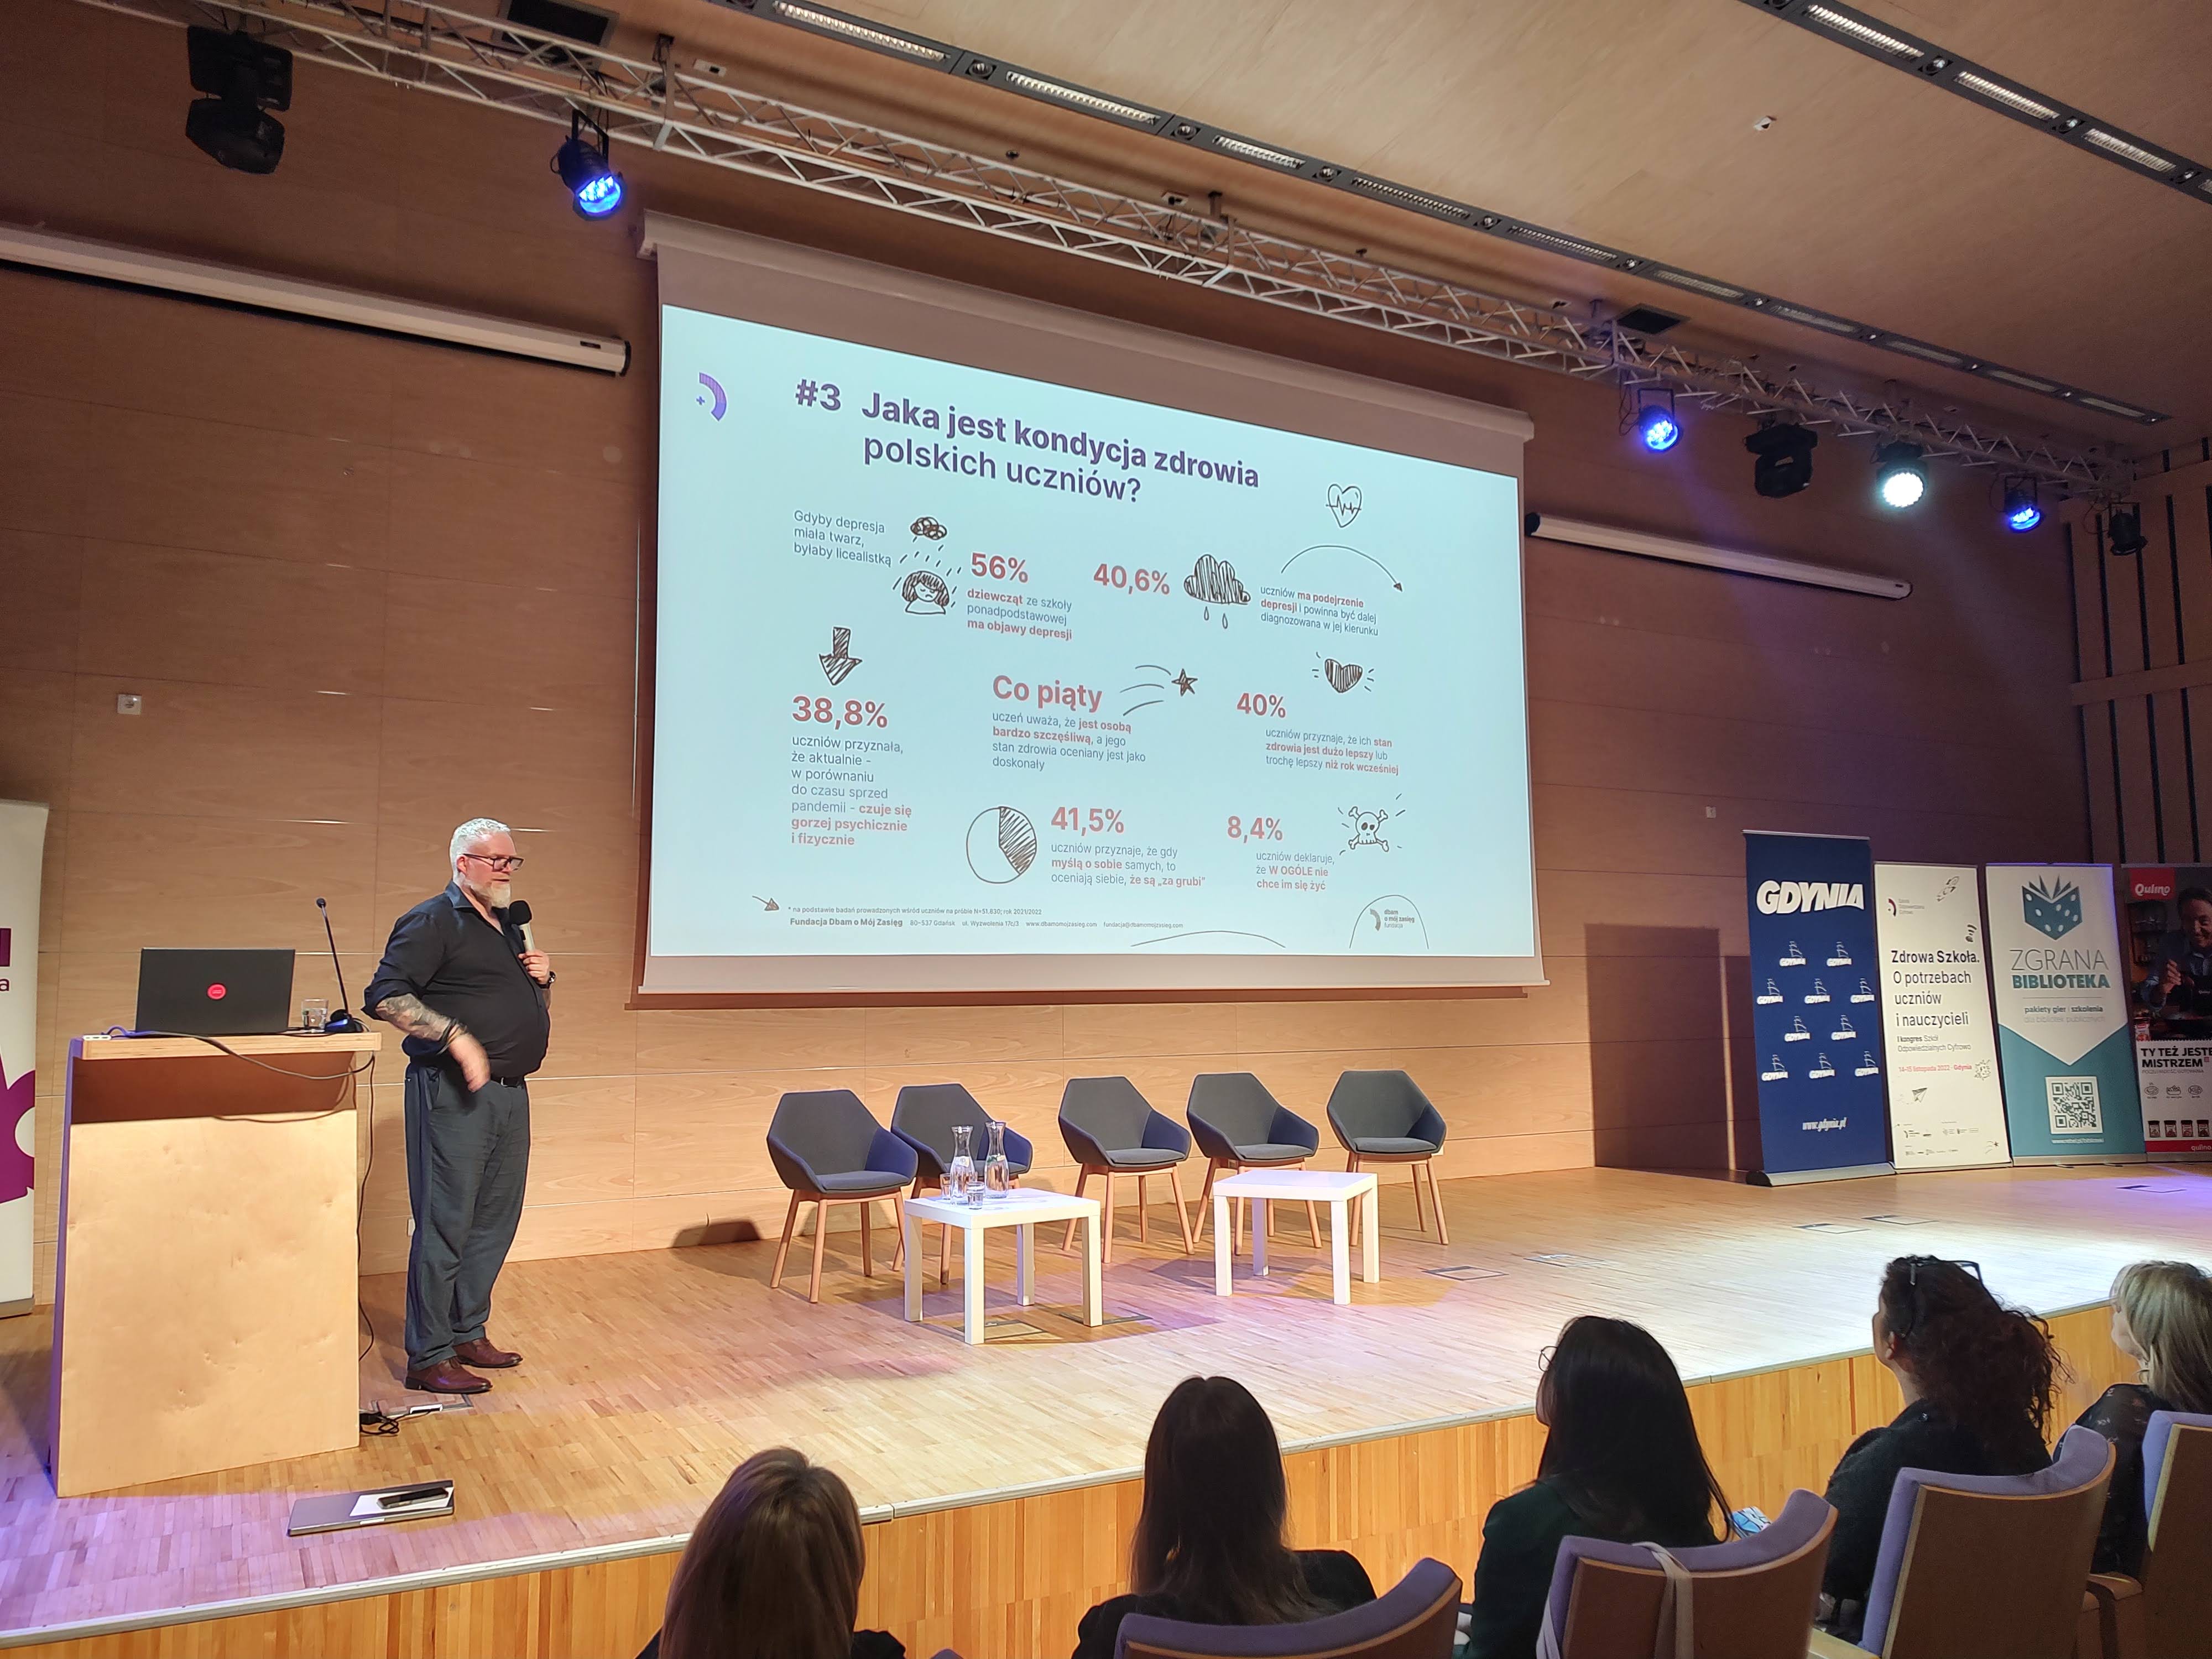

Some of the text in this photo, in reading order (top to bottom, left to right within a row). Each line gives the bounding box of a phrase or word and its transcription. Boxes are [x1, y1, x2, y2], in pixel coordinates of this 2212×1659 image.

[795, 379, 1259, 488] #3 Jaka jest kondycja zdrowia
[864, 435, 1141, 503] polskich uczniów?
[794, 510, 885, 535] Gdyby depresja
[830, 531, 864, 547] twarz,
[836, 547, 891, 567] licealistką
[972, 552, 1028, 583] 56%
[1093, 563, 1170, 594] 40,6%
[967, 588, 1023, 606] dziewcząt
[1026, 597, 1037, 606] ze
[1260, 586, 1364, 608] uczniów ma podejrzenie
[967, 604, 1067, 627] ponadpodstawowej
[1261, 599, 1376, 625] depresji powinna być dalej
[967, 620, 1072, 641] ma objawy depresji
[1261, 612, 1321, 628] diagnozowana
[1332, 621, 1342, 633] jej
[1344, 623, 1378, 636] kierunku
[993, 675, 1103, 713] Co piąty
[792, 696, 888, 730] 38,8%
[1237, 693, 1286, 718] 40%
[993, 712, 1131, 734] uczeń uważa, że jest osobą
[792, 736, 841, 748] uczniów
[993, 726, 1031, 738] bardzo
[1034, 732, 1093, 745] szczęśliwą,
[1105, 735, 1126, 748] jego
[1266, 729, 1392, 747] uczniów przyznaje, że ich stan
[791, 751, 862, 765] że aktualnie
[993, 742, 1146, 763] stan zdrowia oceniany jest jako
[1266, 742, 1387, 760] zdrowia jest dużo lepszy lub
[1266, 755, 1399, 776] trochę lepszy niż rok wcześniej
[791, 769, 873, 782] w porównaniu
[791, 784, 888, 800] do czasu sprzed
[791, 801, 912, 818] pandemii czuje się
[791, 818, 907, 831] gorzej psychicznie
[1051, 806, 1124, 836] 41,5%
[1227, 816, 1283, 843] 8,4%
[791, 833, 855, 846] i fizycznie
[1051, 842, 1177, 859] uczniów przyznaje, że gdy
[1256, 851, 1335, 865] uczniów deklaruje,
[1051, 858, 1176, 873] myślą o sobie samych, to
[1256, 864, 1328, 877] że W OGÓLE nie
[1051, 873, 1092, 885] oceniają
[1095, 874, 1126, 886] siebie,
[1130, 874, 1141, 884] że
[1144, 877, 1155, 886] są
[1256, 879, 1326, 892] chce im się żyć
[1756, 880, 1864, 915] GDYNIA
[790, 918, 827, 926] Fundacja
[860, 918, 875, 926] Mój
[877, 919, 903, 927] Zasięg
[1891, 950, 1980, 963] Zdrowa Szkoła.
[2010, 949, 2109, 971] ZGRANA
[1893, 971, 1971, 987] O potrzebach
[2012, 974, 2110, 989] BIBLIOTEKA
[1895, 990, 1942, 1004] uczniów
[2024, 1006, 2051, 1014] pakiety
[2052, 1006, 2066, 1014] gier
[1896, 1011, 1969, 1028] i nauczycieli
[2141, 1048, 2156, 1057] TY
[2158, 1045, 2179, 1056] TEŻ
[2142, 1058, 2203, 1068] MISTRZEM
